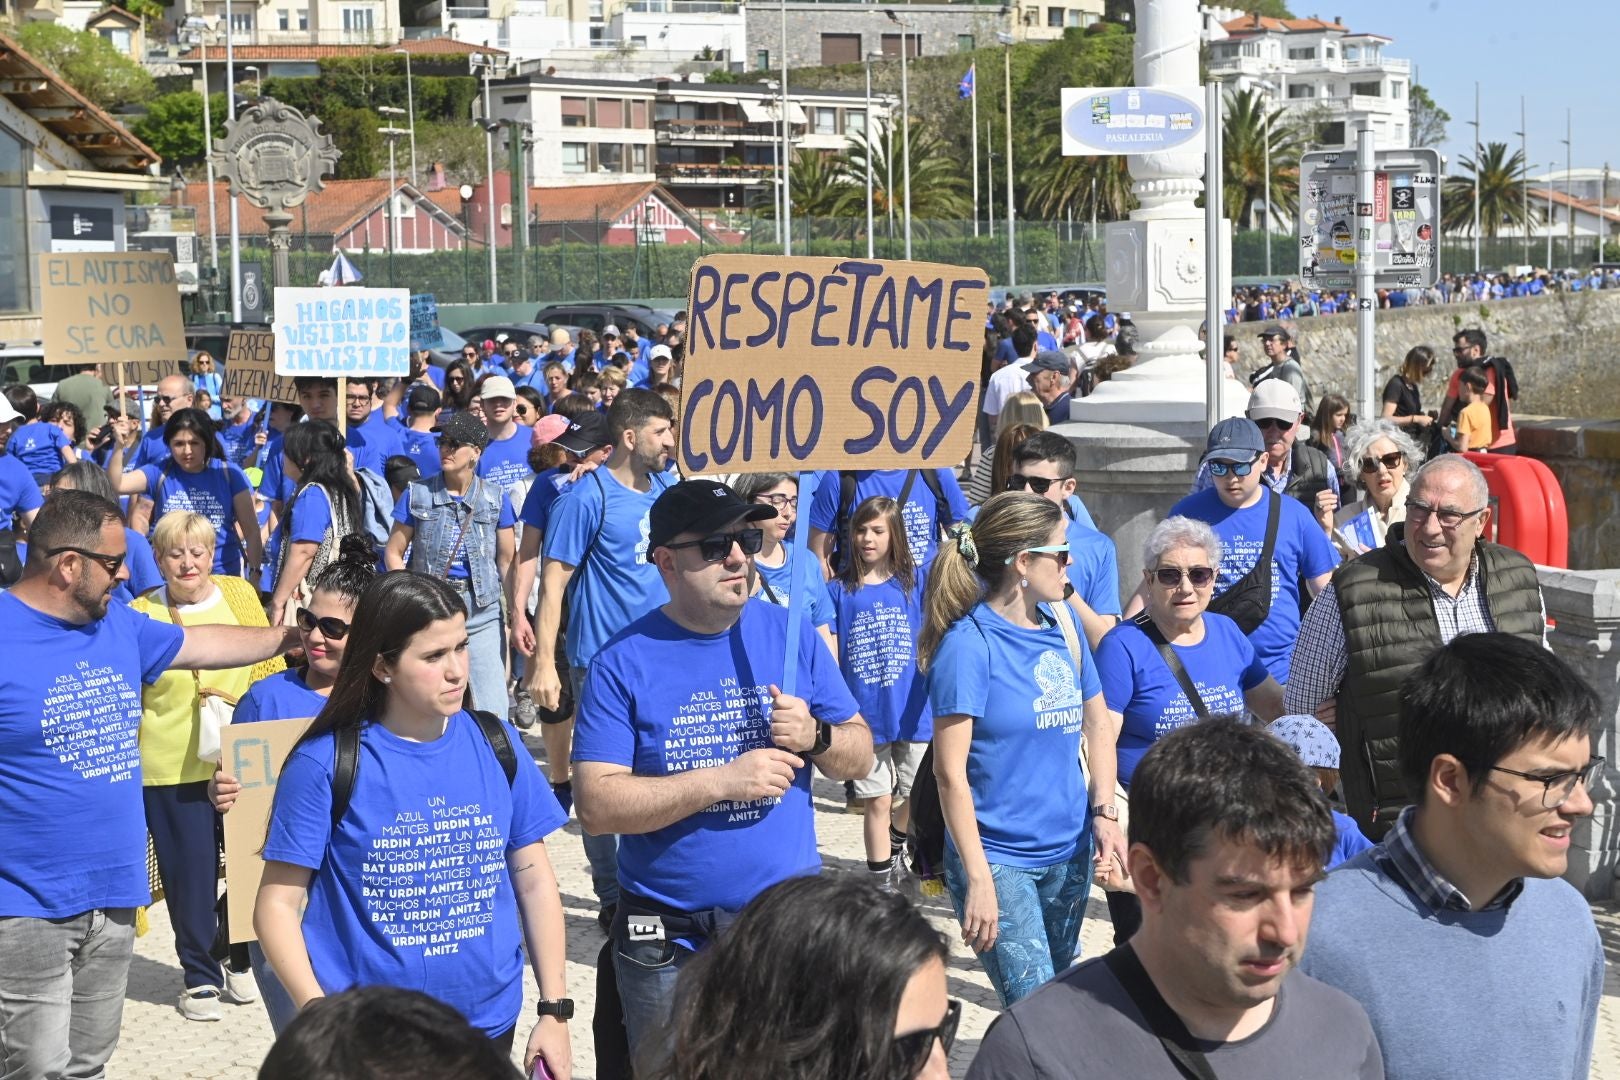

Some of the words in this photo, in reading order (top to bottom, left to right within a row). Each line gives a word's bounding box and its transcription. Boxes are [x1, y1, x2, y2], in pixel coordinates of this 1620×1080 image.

[1106, 133, 1163, 142] PASEALEKUA
[49, 260, 80, 286] EL
[84, 259, 174, 284] AUTISMO
[88, 292, 130, 317] NO
[296, 298, 402, 323] HAGAMOS
[689, 261, 986, 355] RESPÉTAME
[66, 325, 100, 354] SE
[106, 323, 165, 349] CURA
[282, 321, 368, 346] VISIBLE
[379, 322, 406, 344] LO
[285, 346, 409, 372] INVISIBLE
[682, 374, 824, 472] COMO
[843, 366, 974, 460] SOY
[76, 661, 89, 670] UN
[48, 682, 82, 695] MATICES
[84, 676, 110, 688] URDIN
[111, 674, 123, 683] BAT
[56, 674, 77, 684] AZUL
[81, 667, 113, 678] MUCHOS
[720, 678, 736, 686] UN
[1194, 681, 1205, 689] UN
[44, 693, 74, 706] URDIN
[77, 688, 101, 699] ANITZ
[102, 686, 115, 694] UN
[117, 683, 132, 691] AZUL
[691, 691, 717, 702] AZUL
[724, 685, 768, 698] MUCHOS
[1224, 690, 1236, 698] BAT
[41, 716, 61, 727] BAT
[64, 709, 91, 721] URDIN
[94, 704, 117, 715] ANITZ
[118, 702, 129, 710] UN
[43, 701, 84, 717] MUCHOS
[86, 694, 118, 707] MATICES
[680, 702, 722, 714] MATICES
[726, 697, 759, 708] URDIN
[762, 696, 774, 704] BA
[42, 721, 85, 737] MUCHOS
[92, 713, 122, 726] MATICES
[673, 714, 706, 726] URDIN
[711, 710, 742, 722] ANITZ
[747, 708, 763, 717] UN
[1155, 722, 1171, 730] BAT
[1160, 714, 1194, 722] MUCHOS
[44, 735, 65, 746] BAT
[69, 728, 98, 741] URDIN
[100, 723, 122, 734] ANITZ
[669, 725, 715, 738] MUCHOS
[720, 718, 762, 732] MATICES
[52, 739, 96, 755] MUCHOS
[665, 739, 686, 749] BAT
[690, 736, 722, 747] URDIN
[726, 730, 758, 742] ANITZ
[60, 752, 80, 764] BAT
[86, 744, 115, 756] URDIN
[666, 748, 712, 760] MUCHOS
[722, 741, 766, 755] MATICES
[72, 760, 95, 772] AZUL
[96, 753, 126, 766] MUCHOS
[82, 766, 111, 779] URDIN
[112, 762, 126, 772] BAT
[667, 761, 688, 771] BAT
[692, 758, 724, 768] URDIN
[110, 771, 132, 784] ANITZ
[427, 796, 446, 807] UN
[701, 802, 730, 813] RDIN
[733, 799, 752, 810] BAT
[755, 797, 781, 806] URDIN
[396, 812, 424, 823] AZUL
[433, 804, 480, 819] MUCHOS
[728, 809, 760, 822] ANITZ
[382, 824, 429, 836] MATICES
[434, 818, 470, 831] URDIN
[474, 815, 493, 826] BAT
[373, 838, 411, 849] URDIN
[416, 833, 450, 847] ANITZ
[455, 830, 472, 841] UN
[477, 827, 500, 839] AZUL
[367, 850, 419, 862] MUCHOS
[424, 843, 471, 858] MATICES
[475, 838, 504, 850] URDIN
[363, 863, 385, 873] BAT
[389, 861, 426, 874] URDIN
[430, 856, 465, 870] ANITZ
[467, 854, 483, 865] UN
[362, 875, 413, 886] MUCHOS
[424, 868, 471, 883] MATICES
[362, 887, 385, 898] BAT
[389, 887, 426, 898] URDIN
[430, 881, 464, 895] ANITZ
[466, 879, 482, 889] UN
[367, 899, 419, 910] MUCHOS
[425, 892, 470, 908] MATICES
[372, 912, 395, 922] BAT
[403, 909, 441, 921] URDIN
[448, 902, 481, 916] ANITZ
[382, 924, 409, 935] AZUL
[412, 920, 454, 932] MUCHOS
[457, 913, 493, 928] MATICES
[392, 935, 427, 947] URDIN
[430, 932, 452, 944] BAT
[454, 926, 484, 940] URDIN
[424, 943, 459, 957] ANITZ
